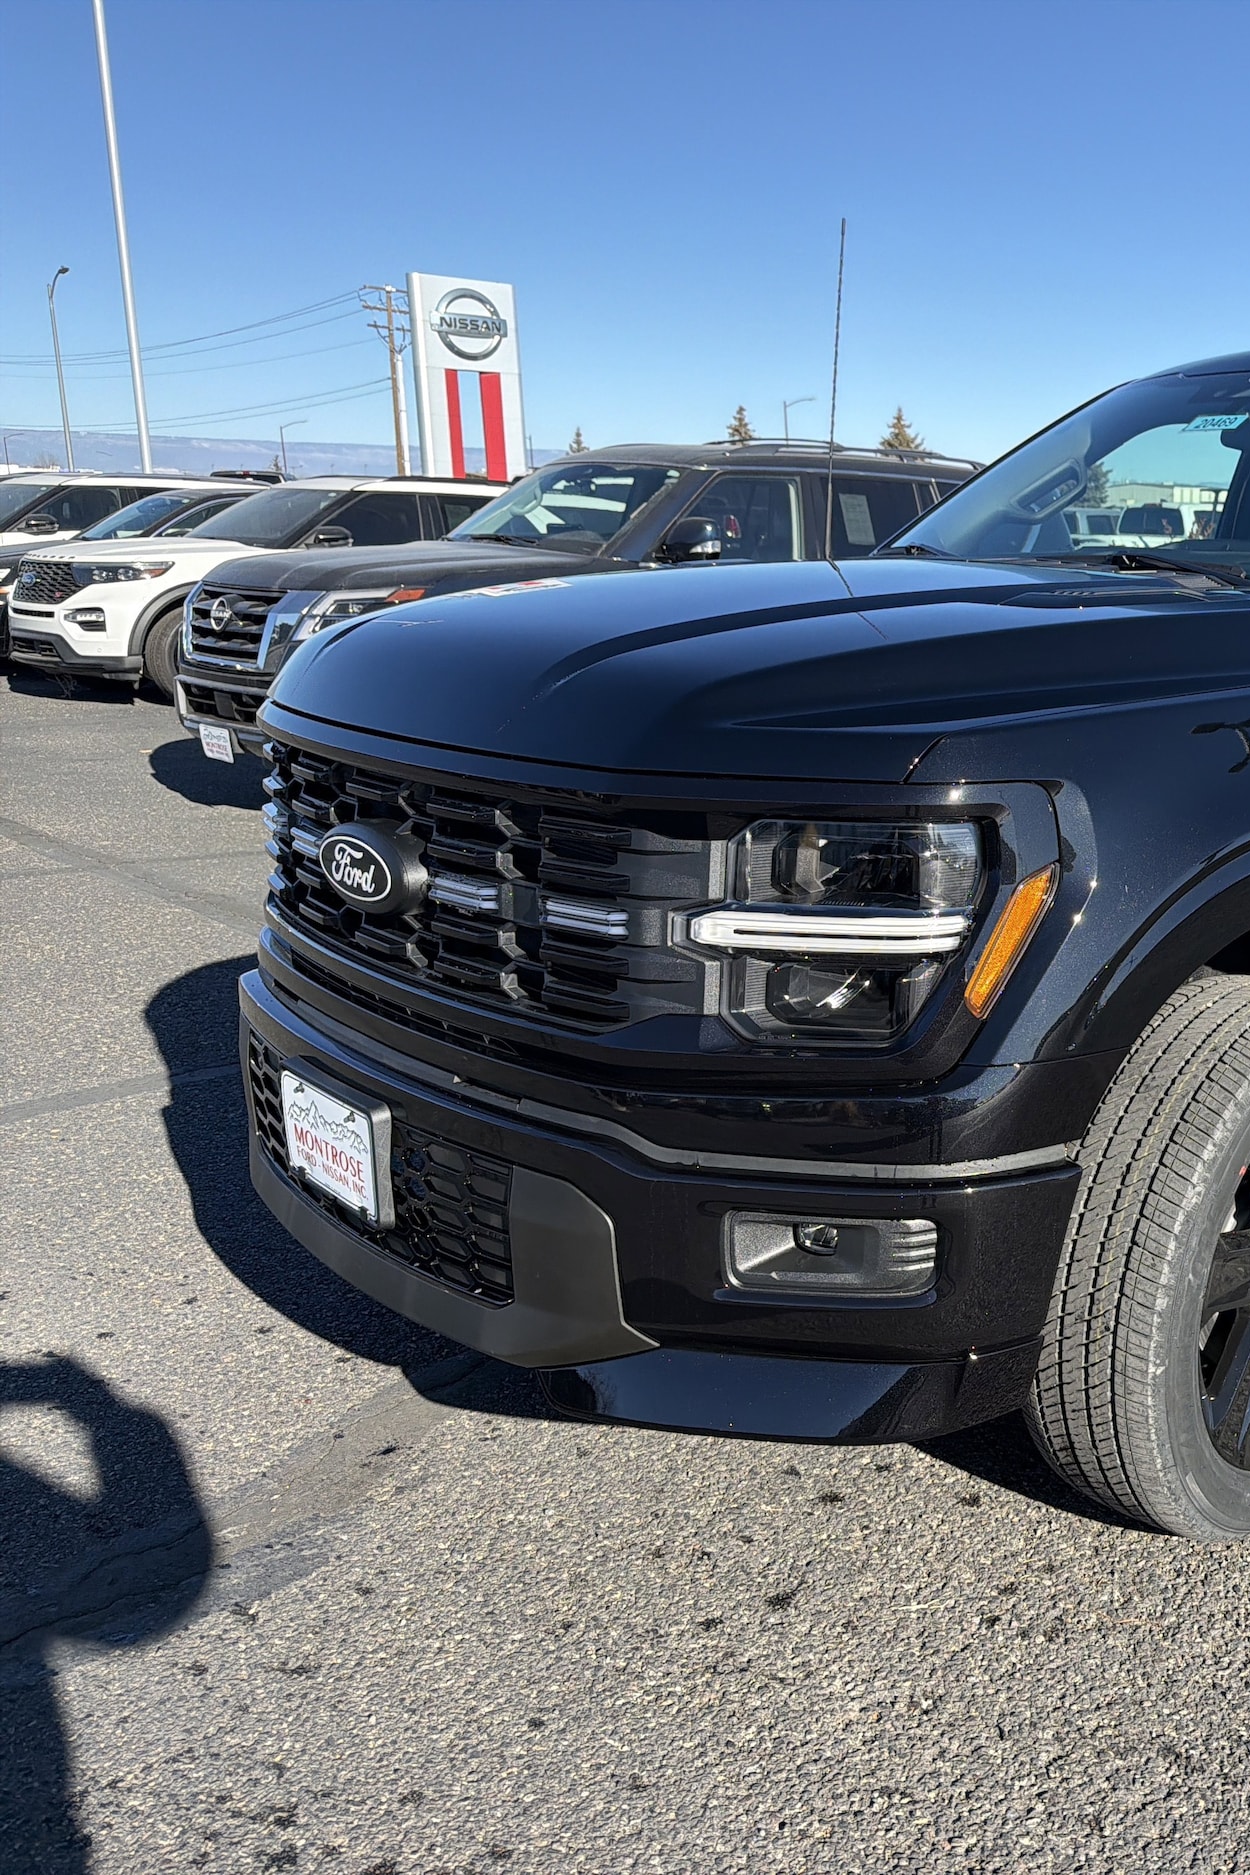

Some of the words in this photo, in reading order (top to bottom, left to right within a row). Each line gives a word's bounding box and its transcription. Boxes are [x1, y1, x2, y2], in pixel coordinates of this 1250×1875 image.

[440, 316, 502, 333] NISSAN
[331, 843, 376, 893] Ford
[294, 1123, 365, 1183] MONTROSE
[297, 1145, 317, 1167] FORD
[352, 1181, 369, 1200] INC.
